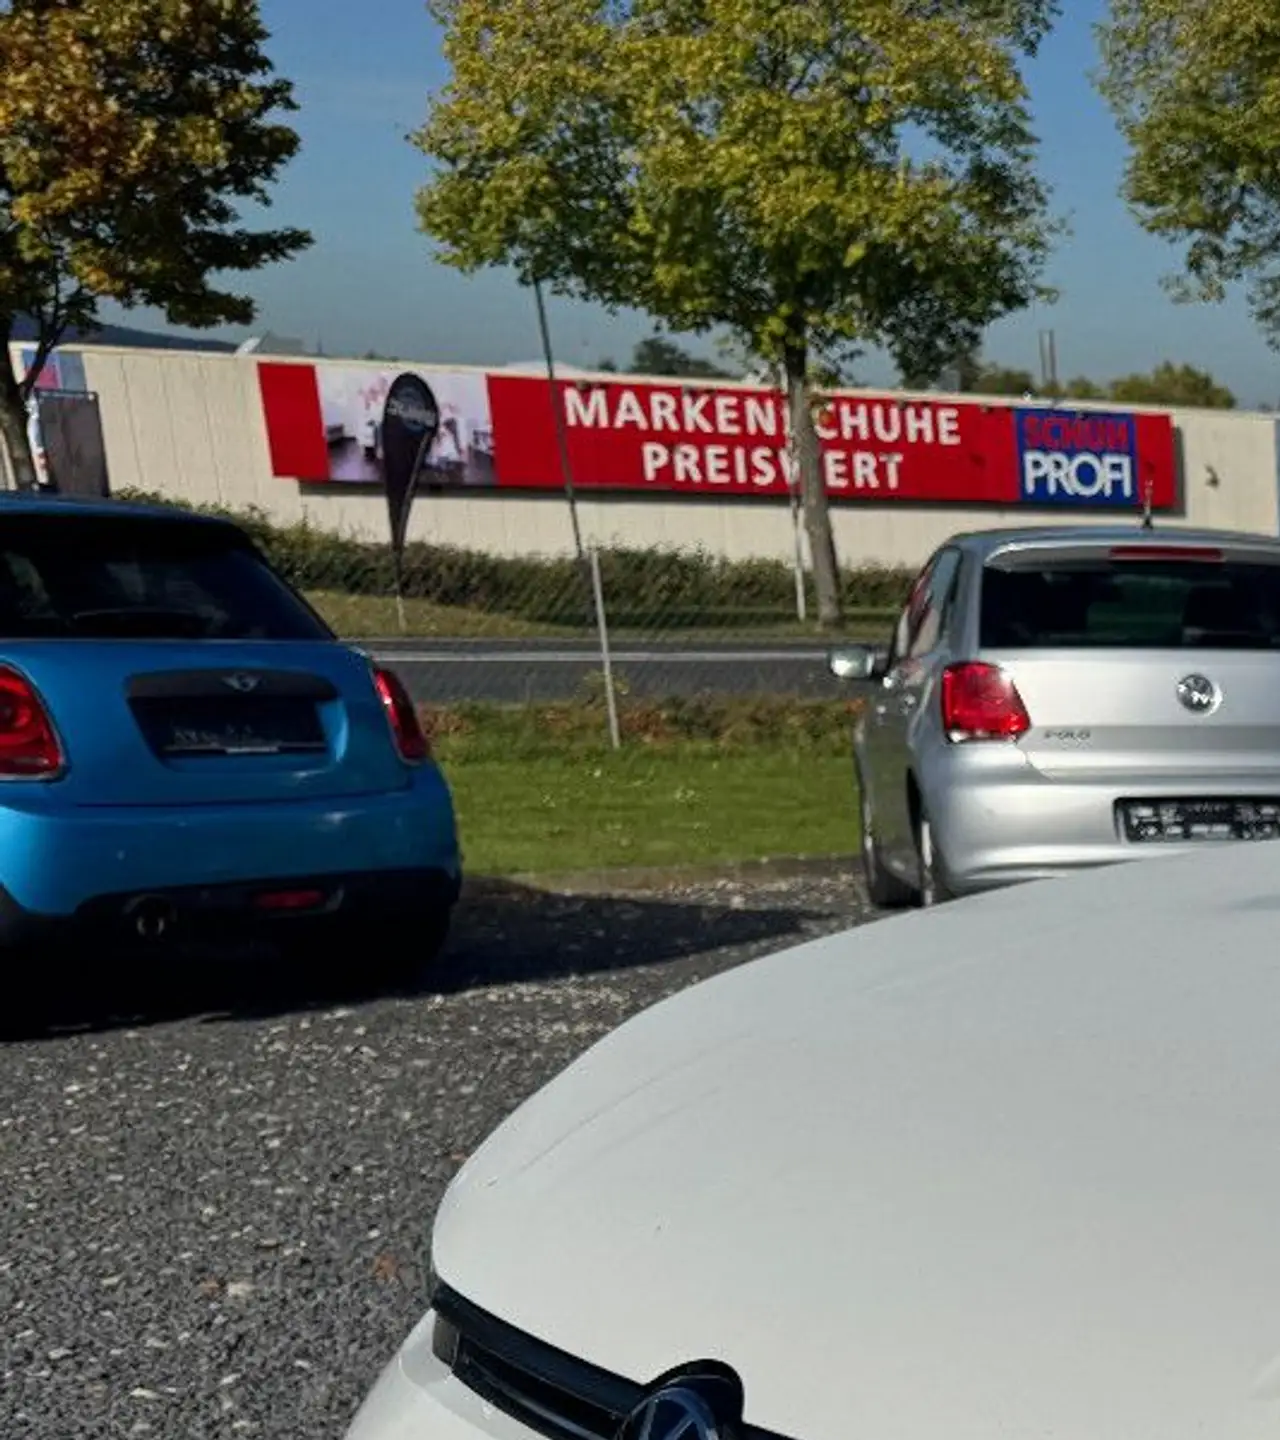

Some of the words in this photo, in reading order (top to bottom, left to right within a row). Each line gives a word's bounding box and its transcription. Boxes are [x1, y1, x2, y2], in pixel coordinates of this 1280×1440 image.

[563, 387, 961, 446] MARKENCHUHE
[1024, 415, 1129, 451] SCHUH
[1023, 450, 1133, 498] PROFI
